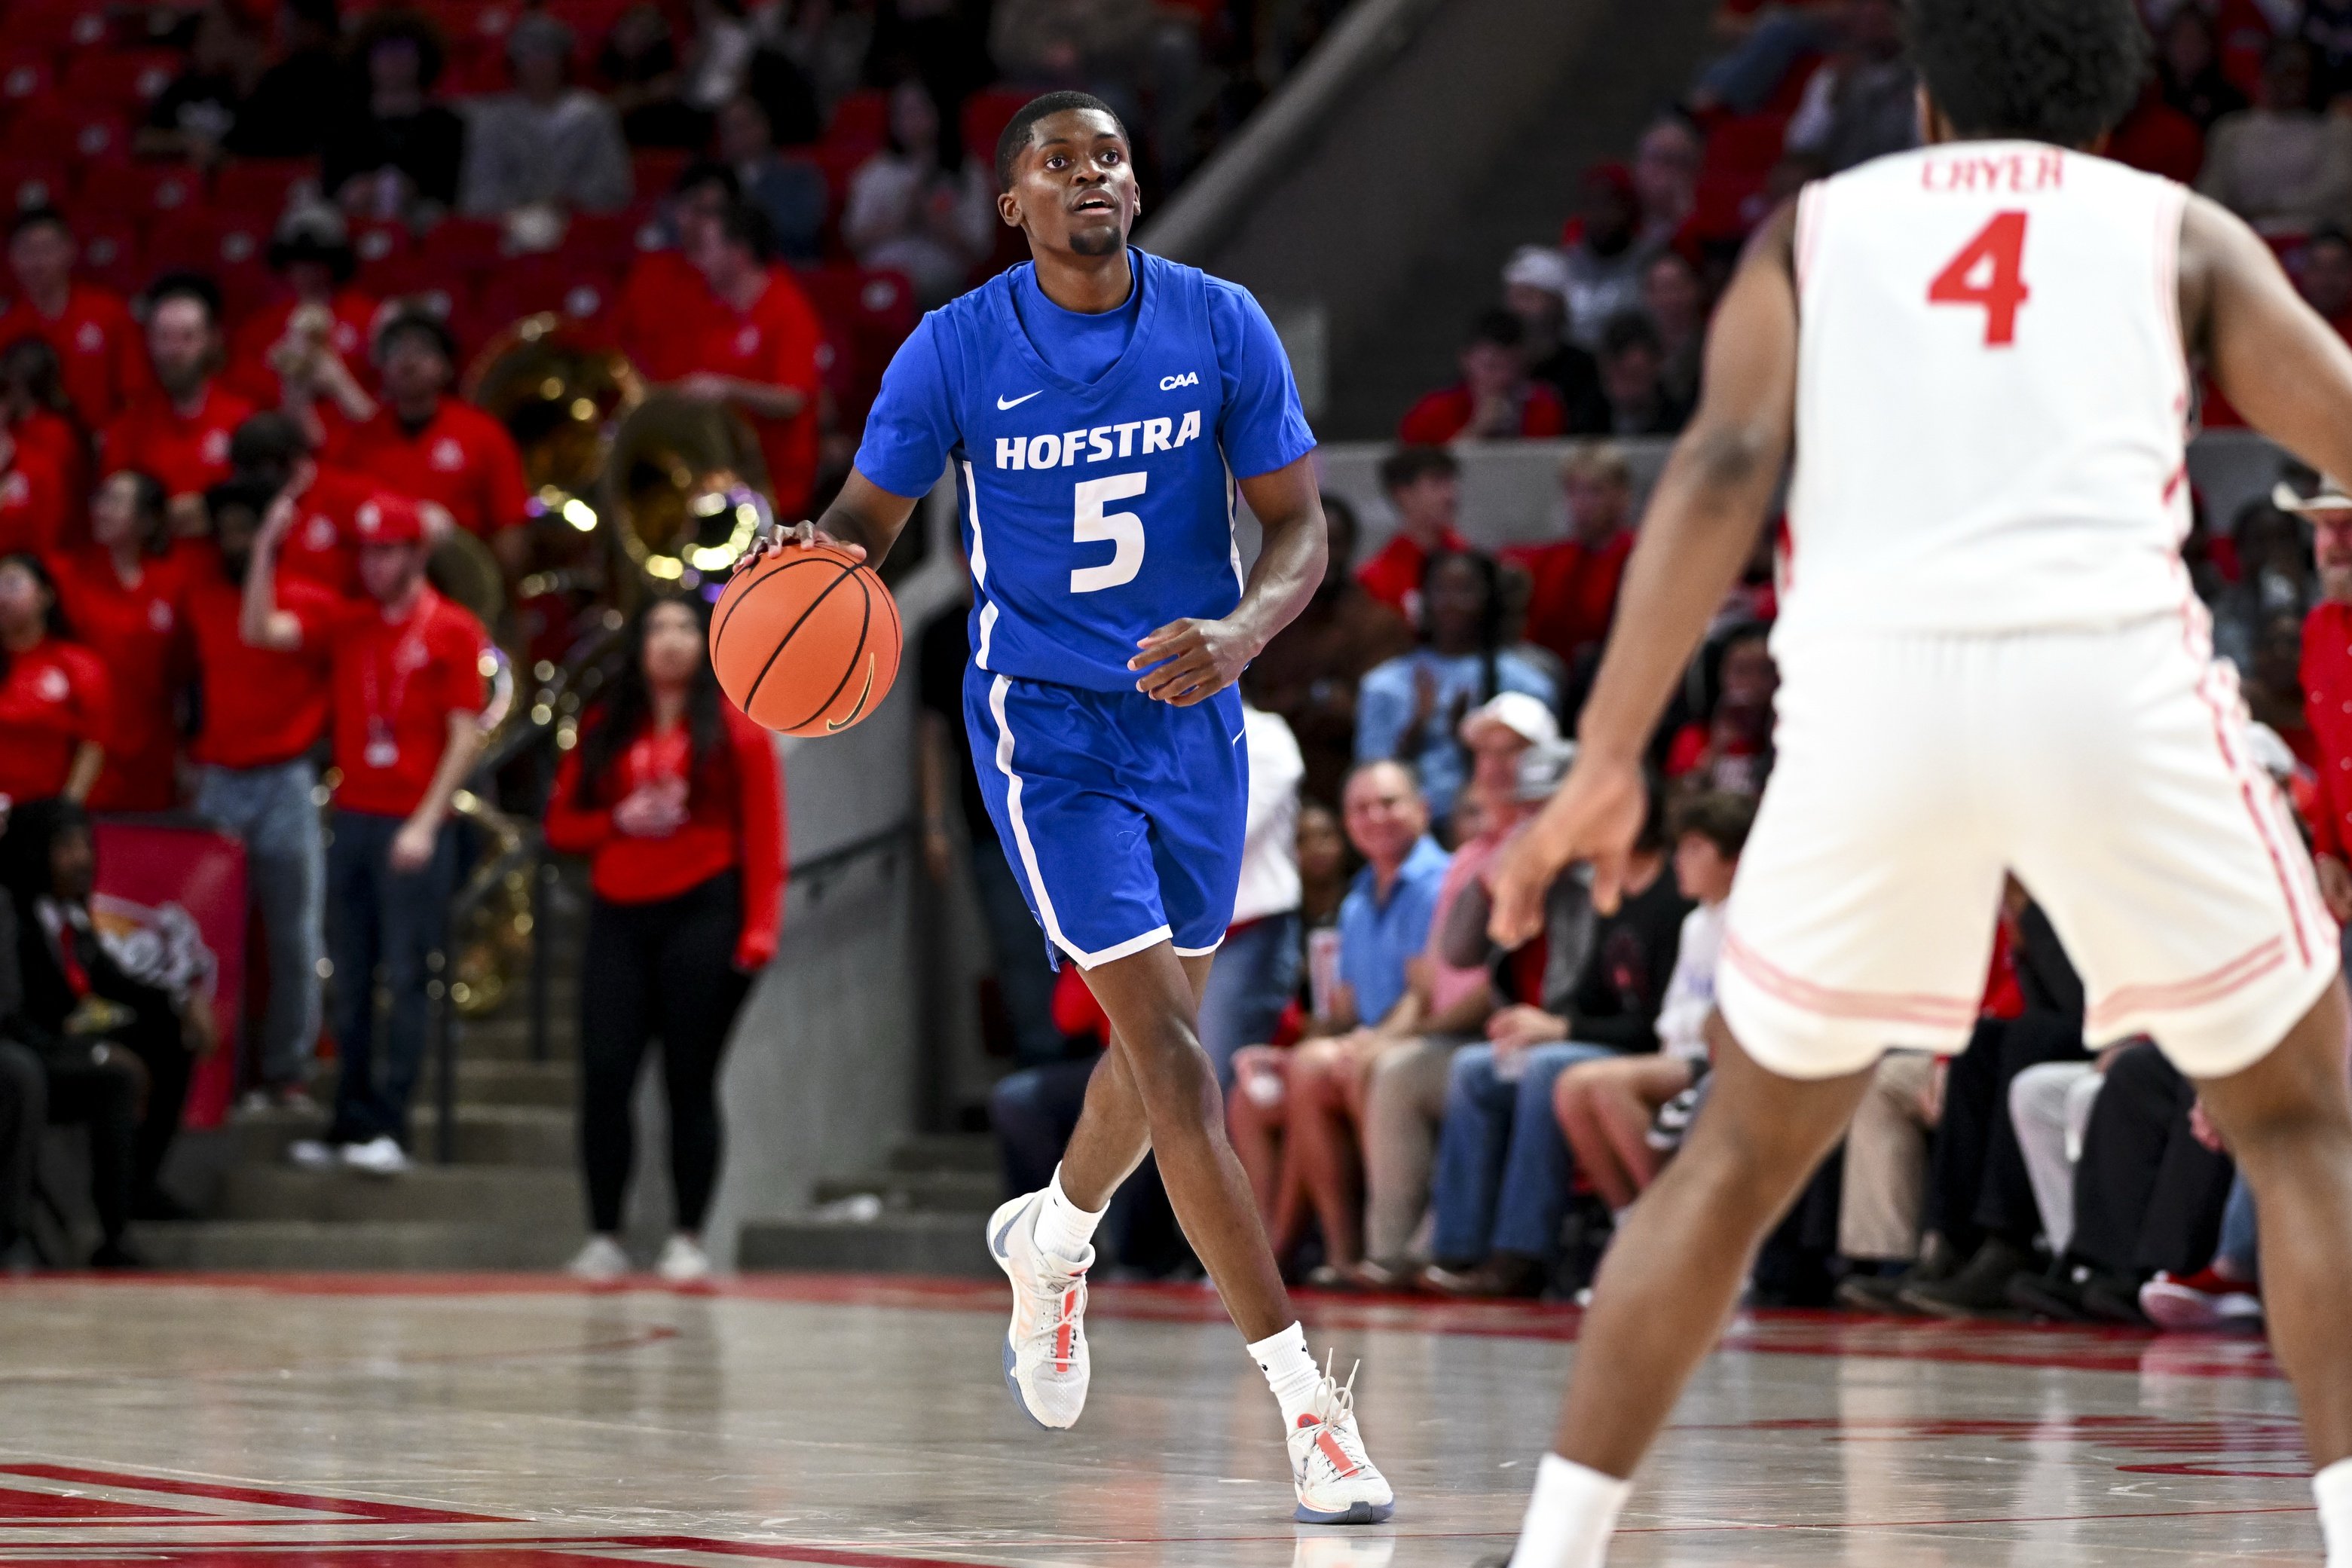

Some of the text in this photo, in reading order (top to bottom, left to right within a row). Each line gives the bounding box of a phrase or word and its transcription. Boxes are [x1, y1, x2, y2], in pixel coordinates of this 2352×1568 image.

[1926, 208, 2030, 347] 4
[1159, 371, 1199, 391] CAA
[996, 410, 1200, 470] HOFSTRA
[1070, 471, 1148, 593] 5
